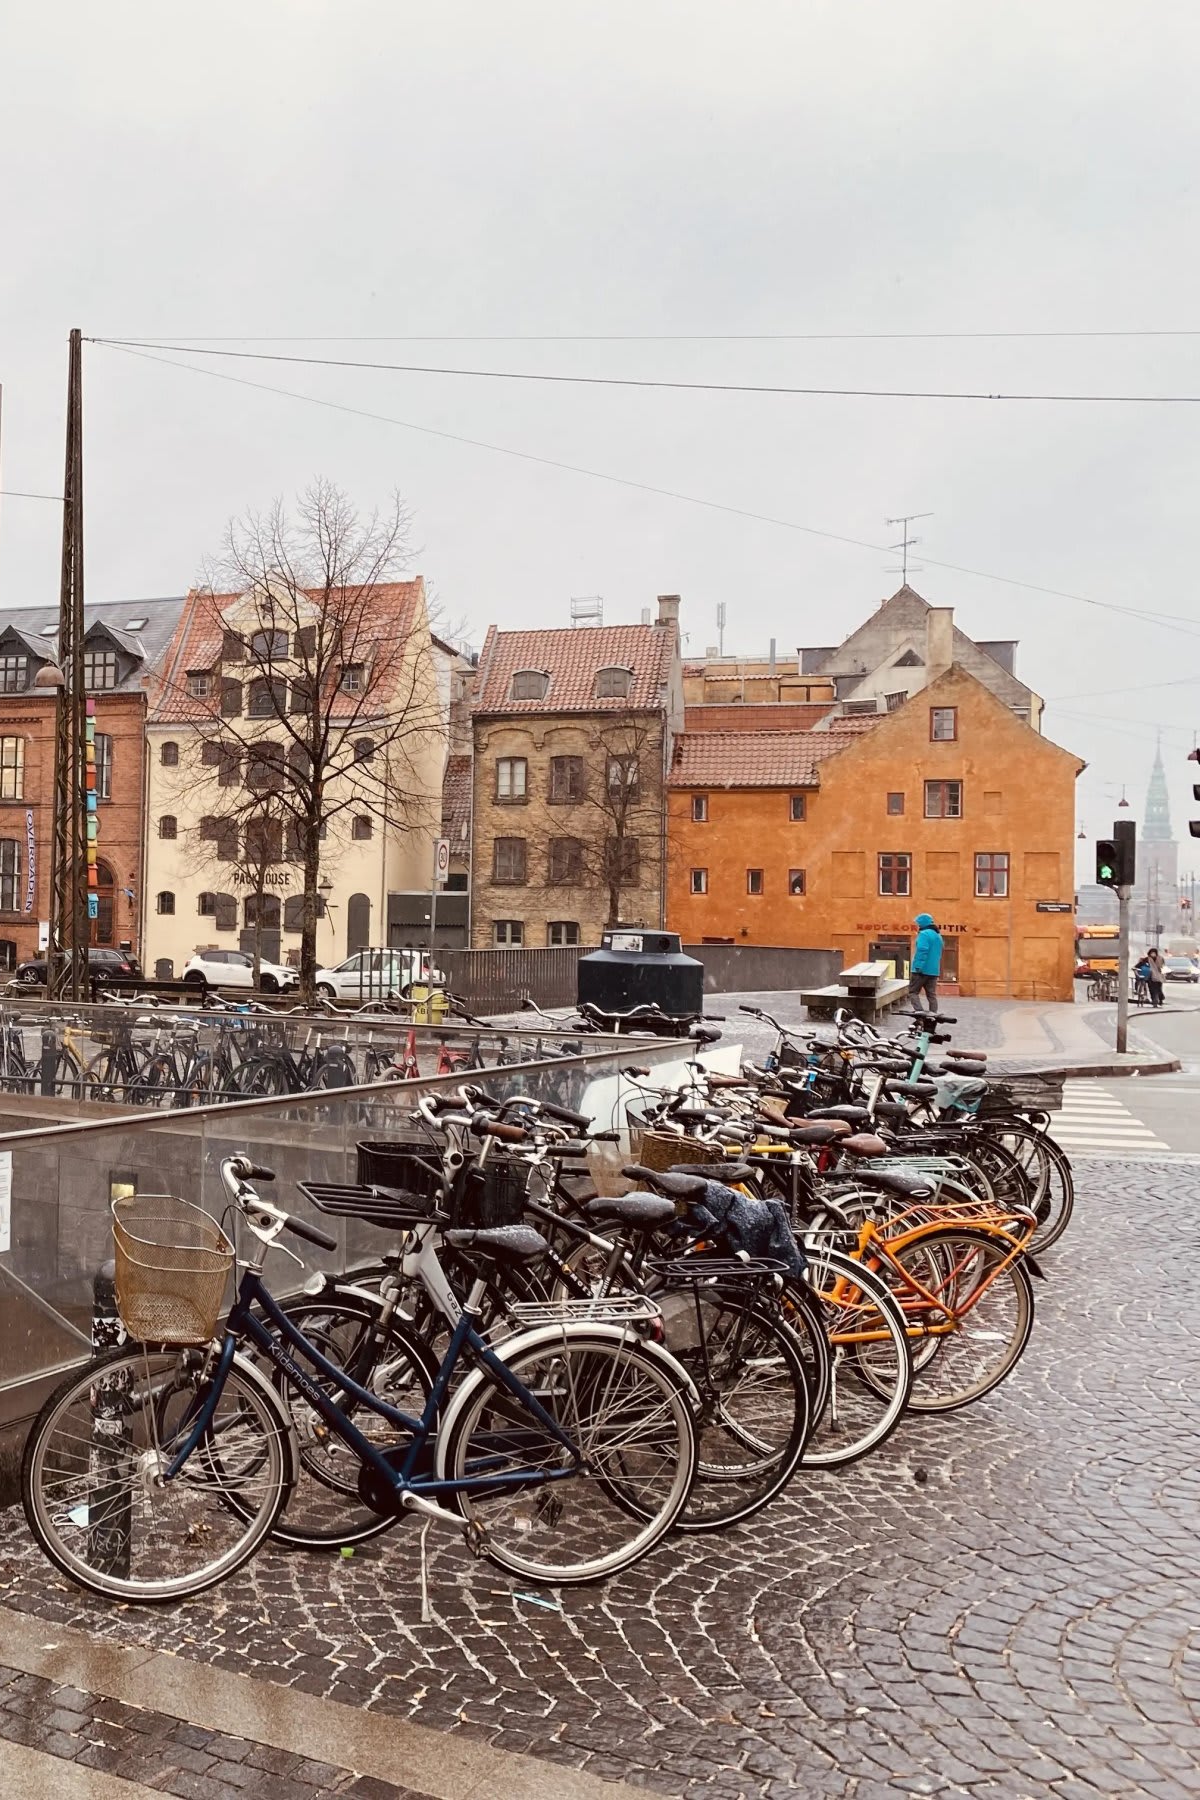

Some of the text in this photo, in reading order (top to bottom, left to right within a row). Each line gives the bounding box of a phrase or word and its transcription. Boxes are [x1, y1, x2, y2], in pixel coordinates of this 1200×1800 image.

[233, 872, 291, 885] PACKOUSE
[892, 923, 918, 932] KOR
[267, 1342, 321, 1401] Kildemoes
